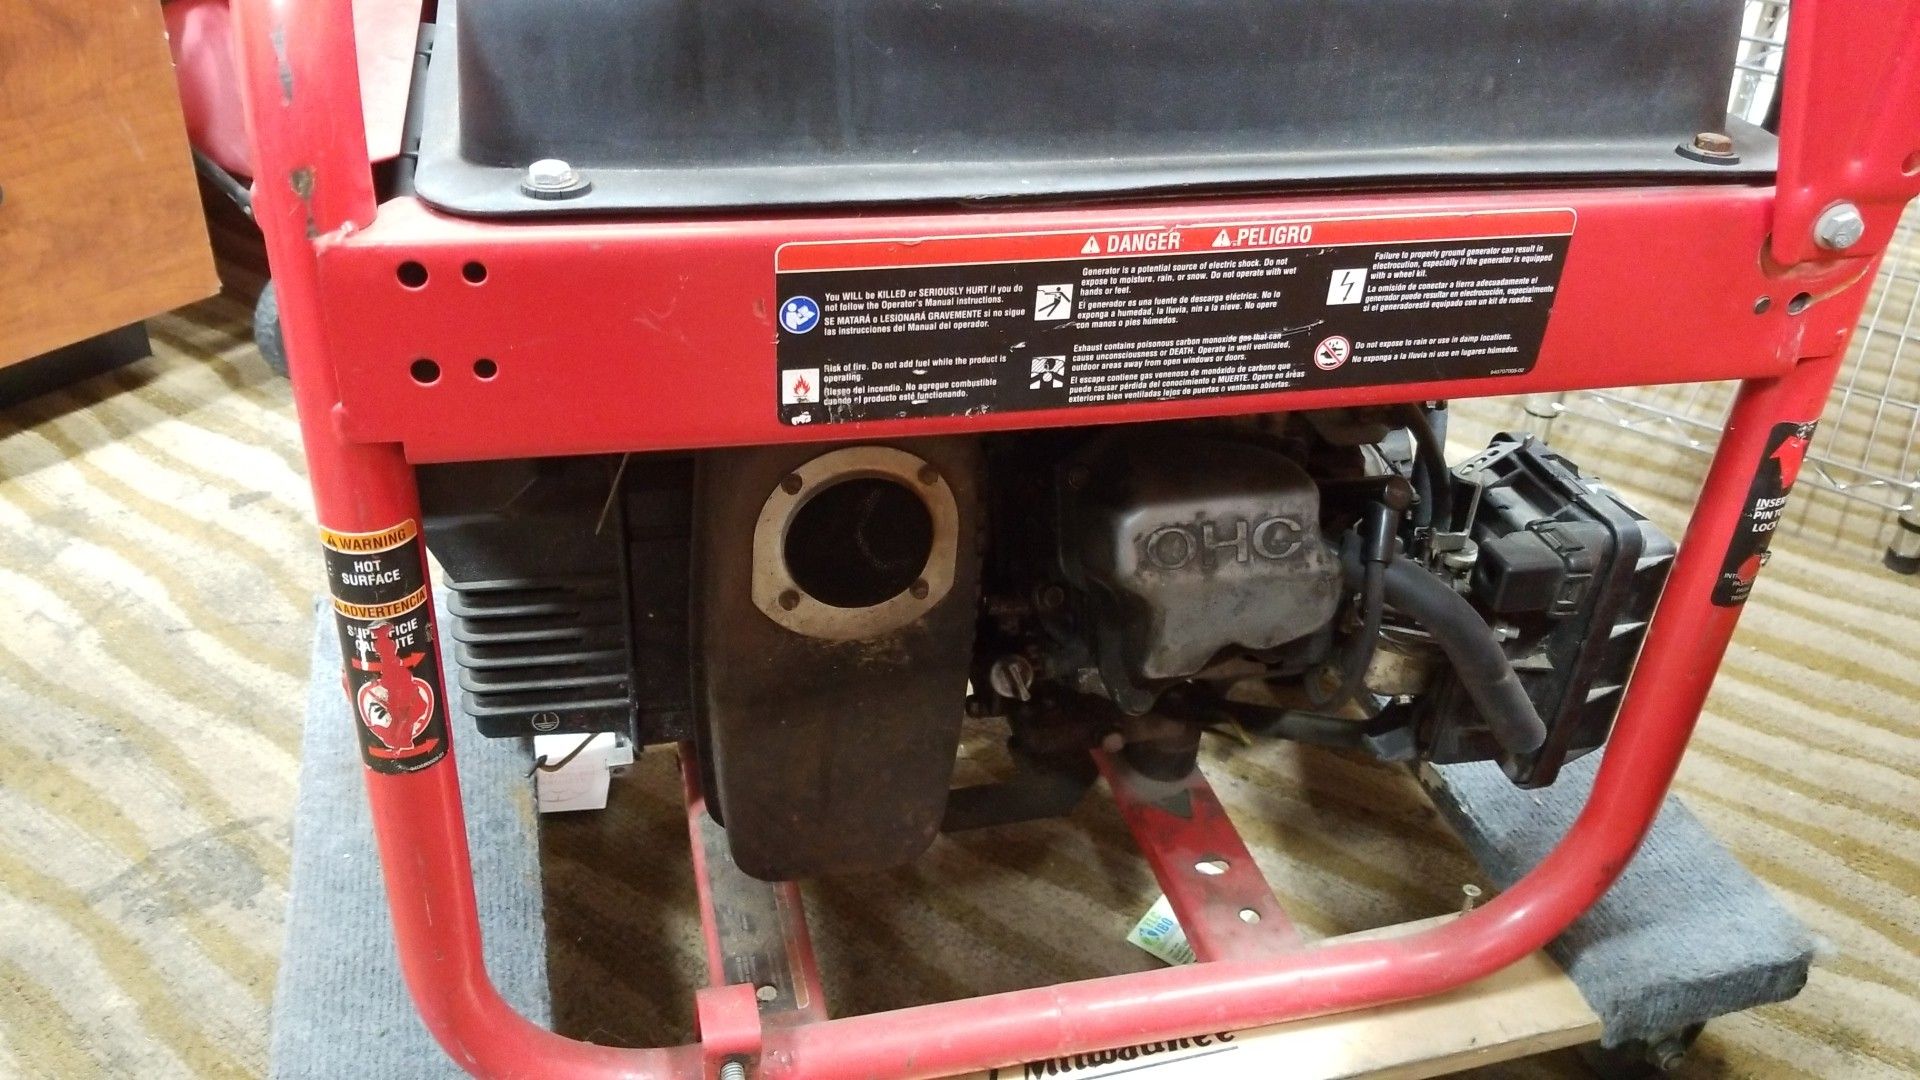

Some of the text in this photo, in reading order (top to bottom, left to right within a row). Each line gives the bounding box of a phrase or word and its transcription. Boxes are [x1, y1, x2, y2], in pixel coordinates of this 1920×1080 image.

[1107, 231, 1181, 253] DANGER
[1236, 225, 1313, 246] PELIGRO
[1082, 258, 1288, 276] Generator potential source electric shock. not
[1081, 278, 1108, 287] expose
[1119, 274, 1156, 285] moisture,
[1157, 273, 1176, 283] rain,
[1222, 270, 1235, 278] not
[1236, 268, 1264, 279] operate
[1265, 267, 1282, 276] with
[1283, 267, 1296, 275] wet
[826, 286, 1011, 302] You WILL KILLED SERIOUSLY HURT you
[1079, 286, 1132, 296] hands feet.
[825, 295, 1004, 312] not follow the Operator's Manual instructions.
[1087, 299, 1126, 311] generador
[1154, 296, 1177, 305] fuente
[1190, 293, 1224, 305] descarga
[836, 308, 1025, 326] MATARÁ LESIONARÁ GRAVEMENTE sigue
[1077, 302, 1277, 321] exponga humedad, lluvia, nieve. opere
[824, 320, 990, 336] las instrucciones del Manual del operador.
[1124, 317, 1141, 328] pies
[1073, 334, 1237, 352] Exhaust contains poisonous carbon monoxide
[1096, 349, 1158, 360] unconsciousness
[1197, 344, 1226, 356] Operate
[1236, 343, 1252, 352] well
[823, 355, 997, 372] Risk fire. not add fuel while the product
[1071, 362, 1099, 372] outdoor
[1101, 362, 1122, 370] areas
[1123, 361, 1143, 370] away
[1144, 358, 1161, 367] from
[1163, 358, 1181, 367] open
[1182, 354, 1214, 364] windows
[823, 372, 864, 384] operating.
[1069, 384, 1092, 395] puede
[1094, 384, 1118, 392] causar
[1148, 379, 1160, 388] del
[1162, 376, 1210, 387] conocimiento
[1252, 372, 1273, 383] Opere
[1079, 363, 1291, 386] escape contiene gas venenoso carbono que
[852, 378, 996, 394] del incendio. agregue combustible
[1068, 392, 1105, 403] exteriores
[1106, 391, 1123, 400] bien
[1124, 388, 1161, 399] ventiladas
[1163, 387, 1181, 398] lejos
[1192, 384, 1219, 396] puertas
[1227, 382, 1259, 392] ventanas
[863, 393, 896, 405] producto
[1756, 496, 1786, 508] INSER
[1753, 510, 1774, 520] PIN
[339, 529, 407, 551] WARNING
[1148, 516, 1303, 570] OHC
[353, 560, 382, 573] HOT
[341, 568, 401, 587] SURFACE
[343, 590, 427, 618] ADVERTENCIA
[346, 618, 419, 640] SUPFICIE
